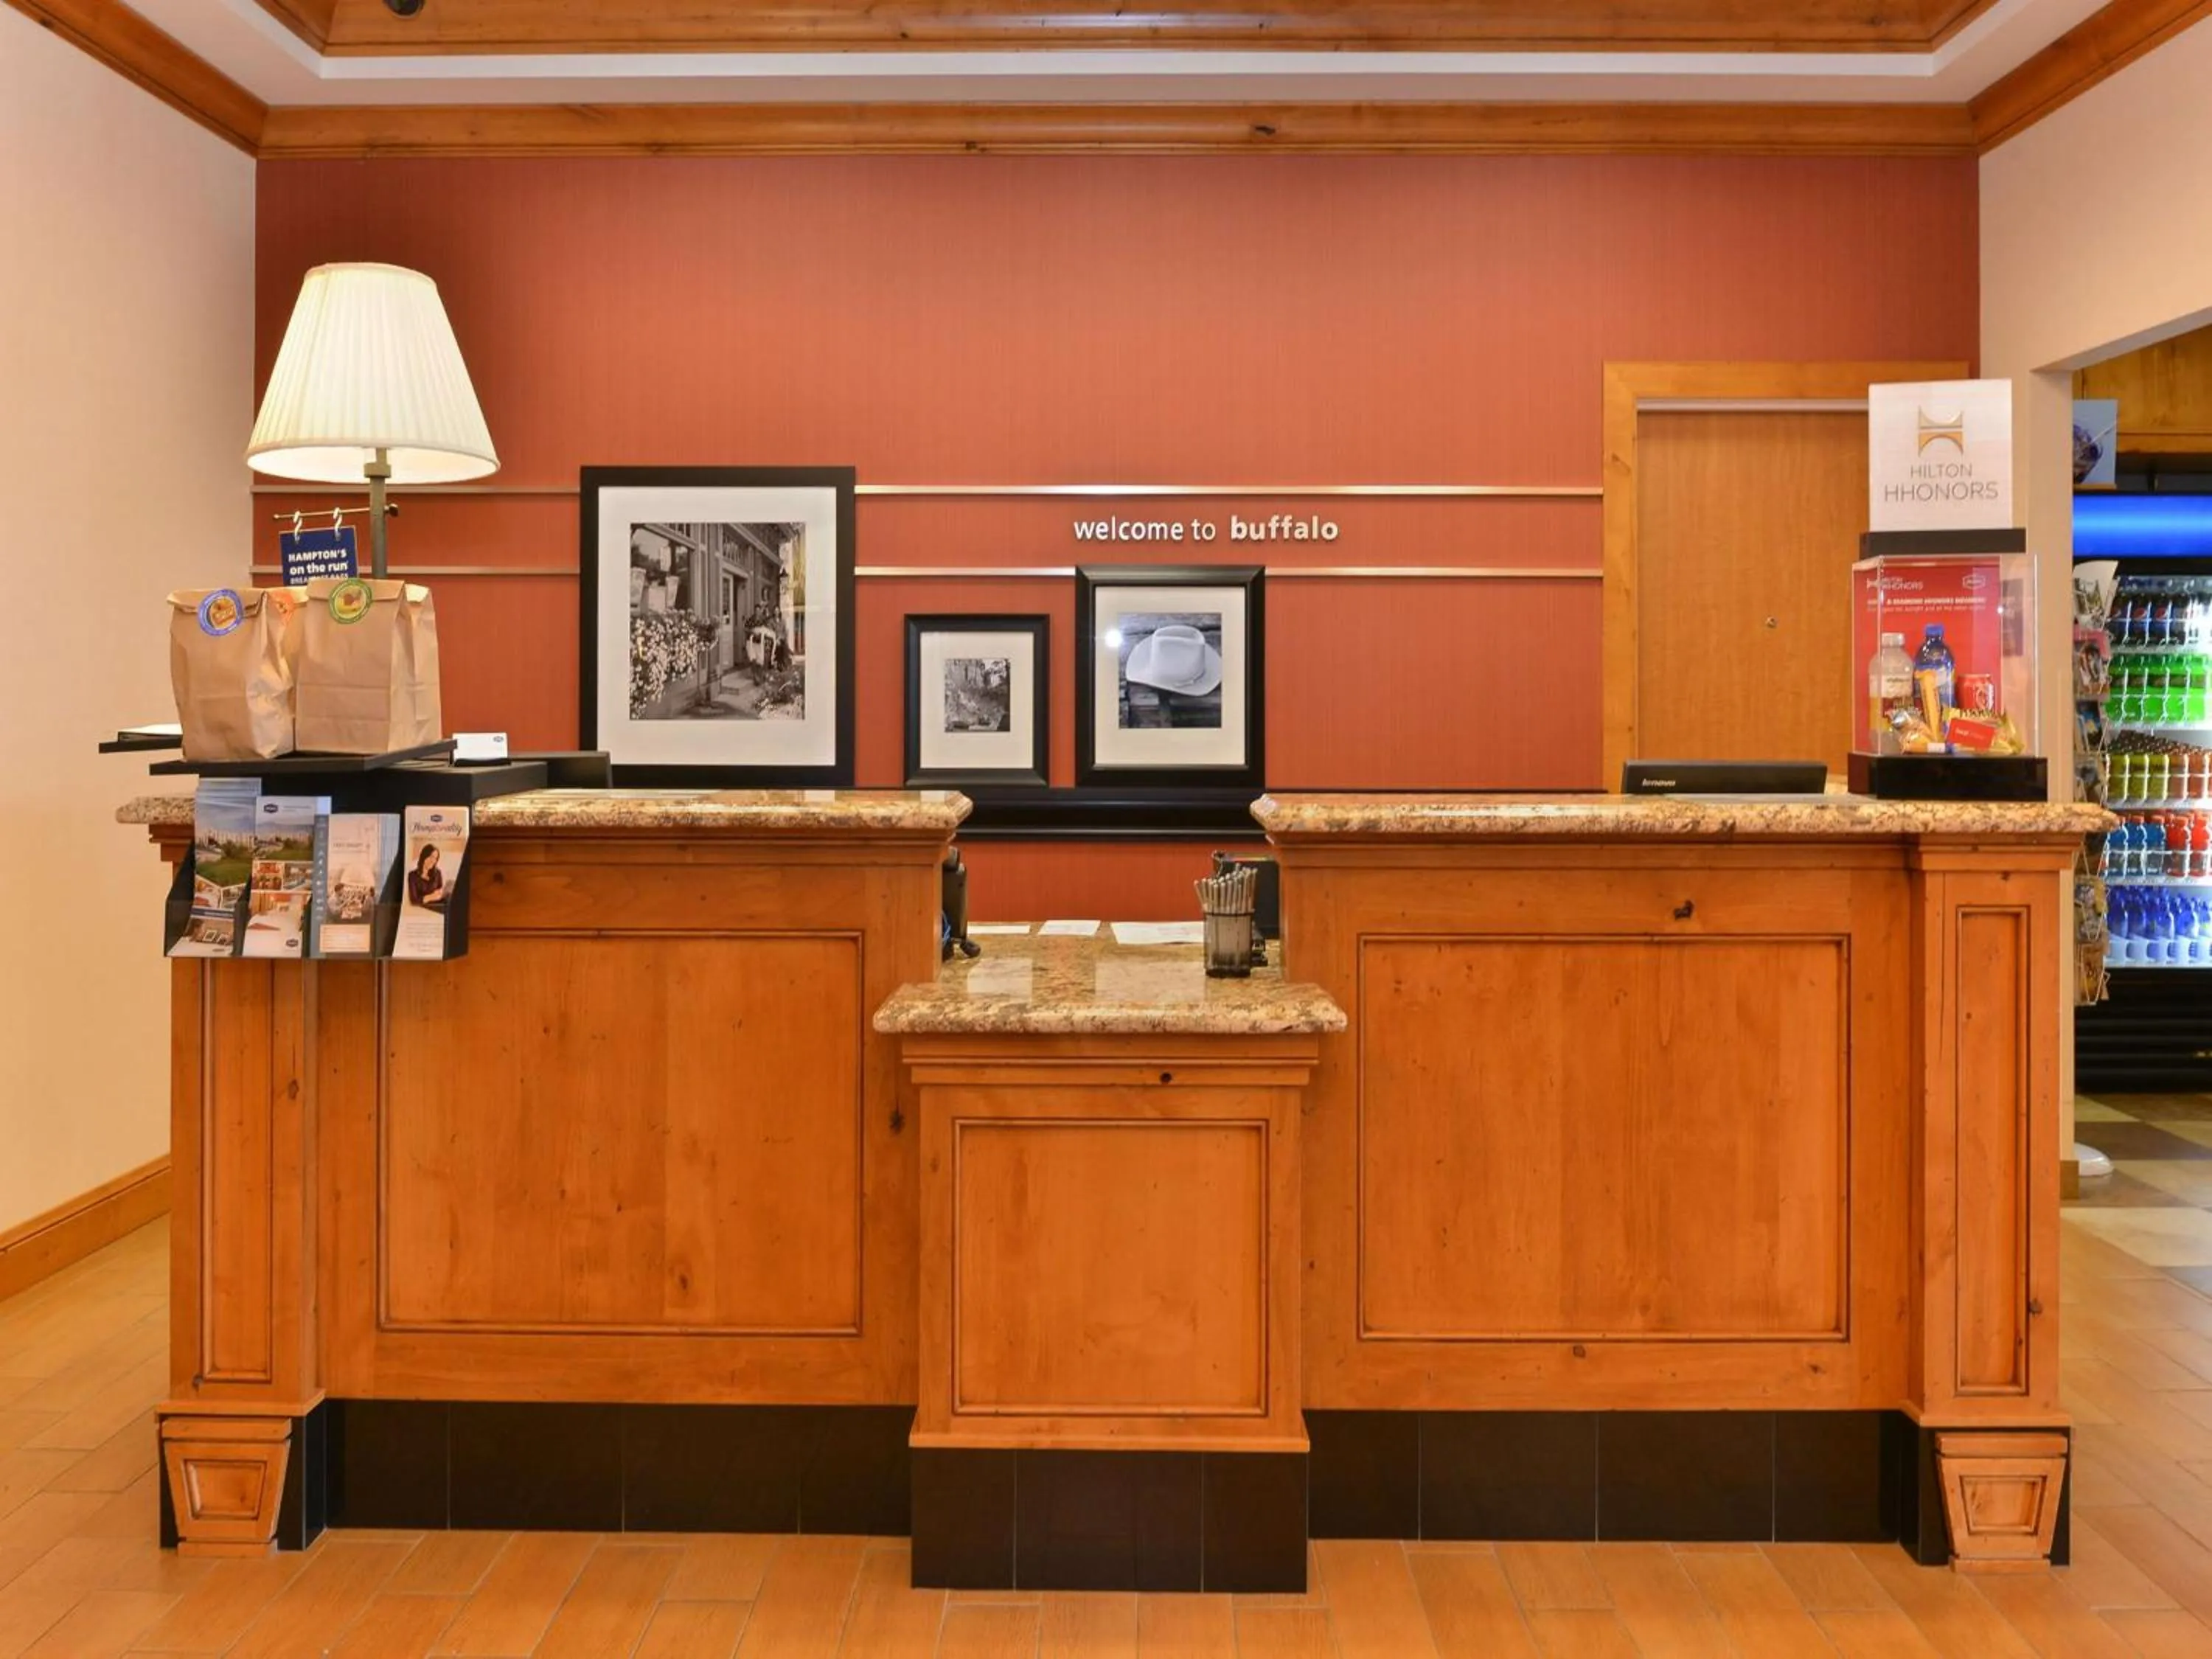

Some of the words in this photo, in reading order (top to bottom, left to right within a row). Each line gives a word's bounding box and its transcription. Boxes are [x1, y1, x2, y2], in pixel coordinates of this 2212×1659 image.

[1910, 463, 1972, 479] HILTON
[1884, 481, 1999, 502] HHONORS
[1074, 515, 1184, 540] welcome
[1191, 518, 1217, 540] to
[1230, 514, 1339, 540] buffalo
[288, 549, 347, 562] HAMPTON'S
[290, 566, 305, 575] on
[306, 562, 325, 574] the
[328, 562, 348, 572] run
